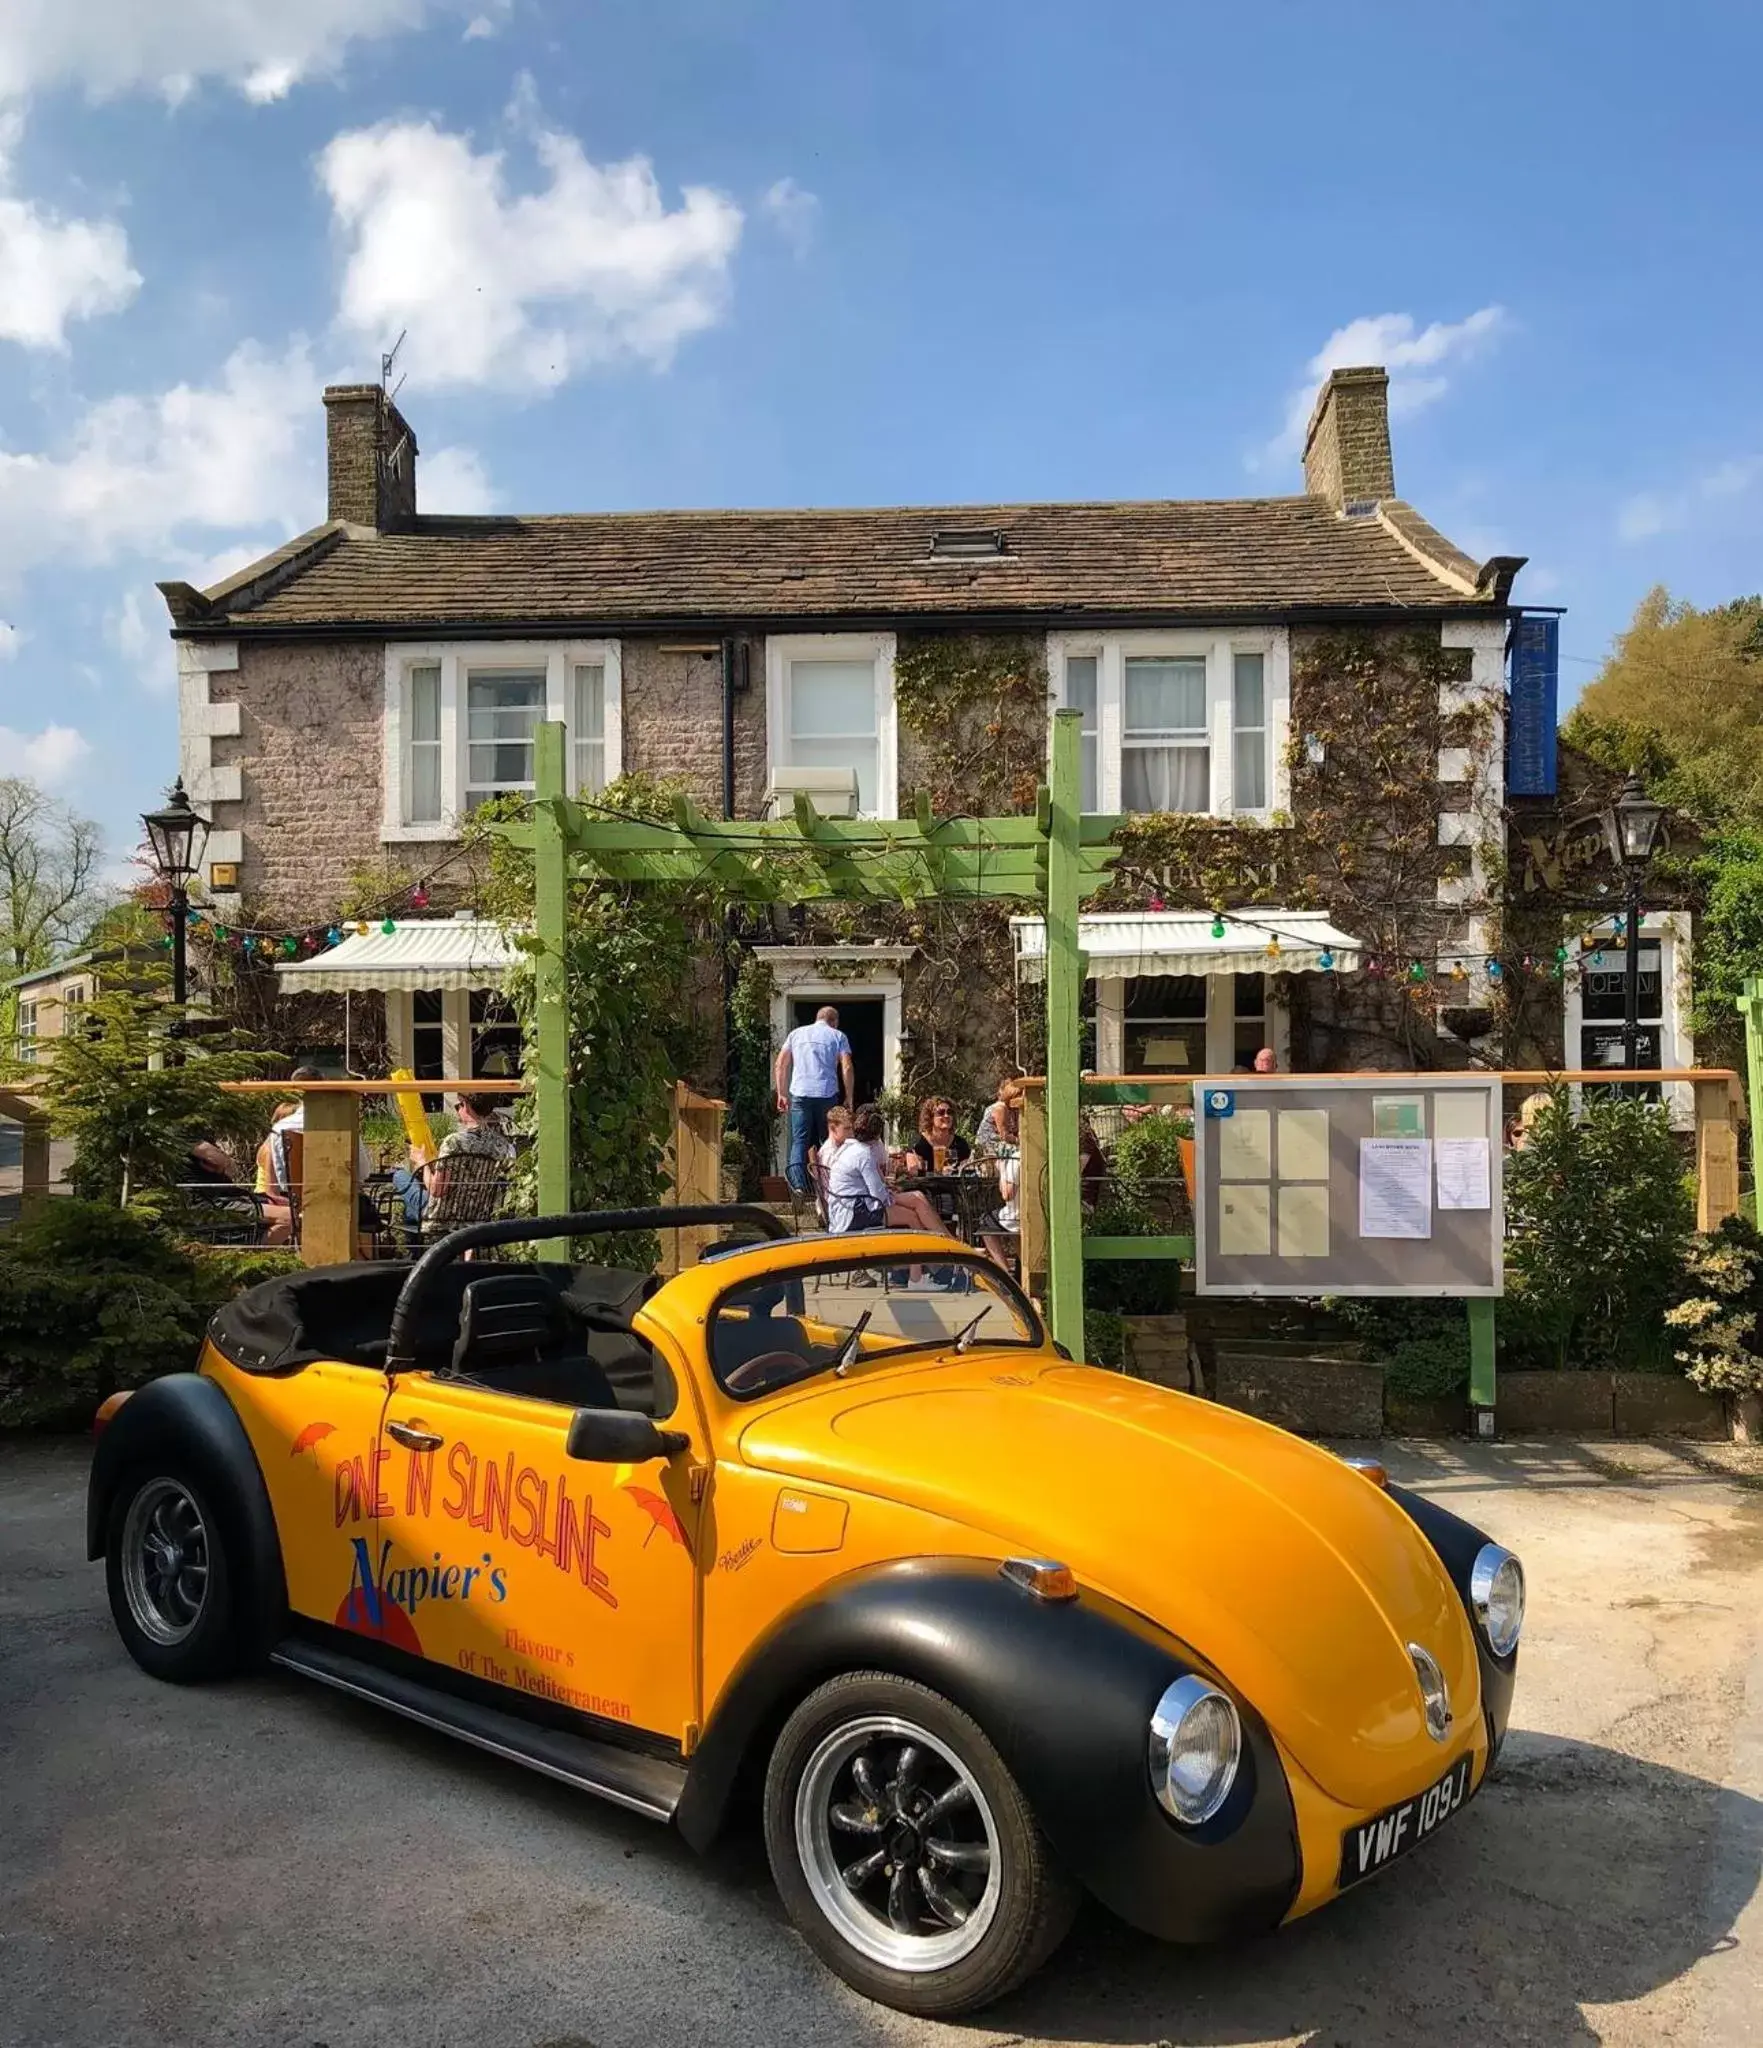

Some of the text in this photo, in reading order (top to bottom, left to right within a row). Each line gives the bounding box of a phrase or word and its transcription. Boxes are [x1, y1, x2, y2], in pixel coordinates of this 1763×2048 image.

[442, 1441, 619, 1610] SUNSHINE
[346, 1537, 508, 1628] Napier's
[457, 1648, 633, 1720] Of The Mediterranean
[1358, 1761, 1467, 1873] VWF 109J
